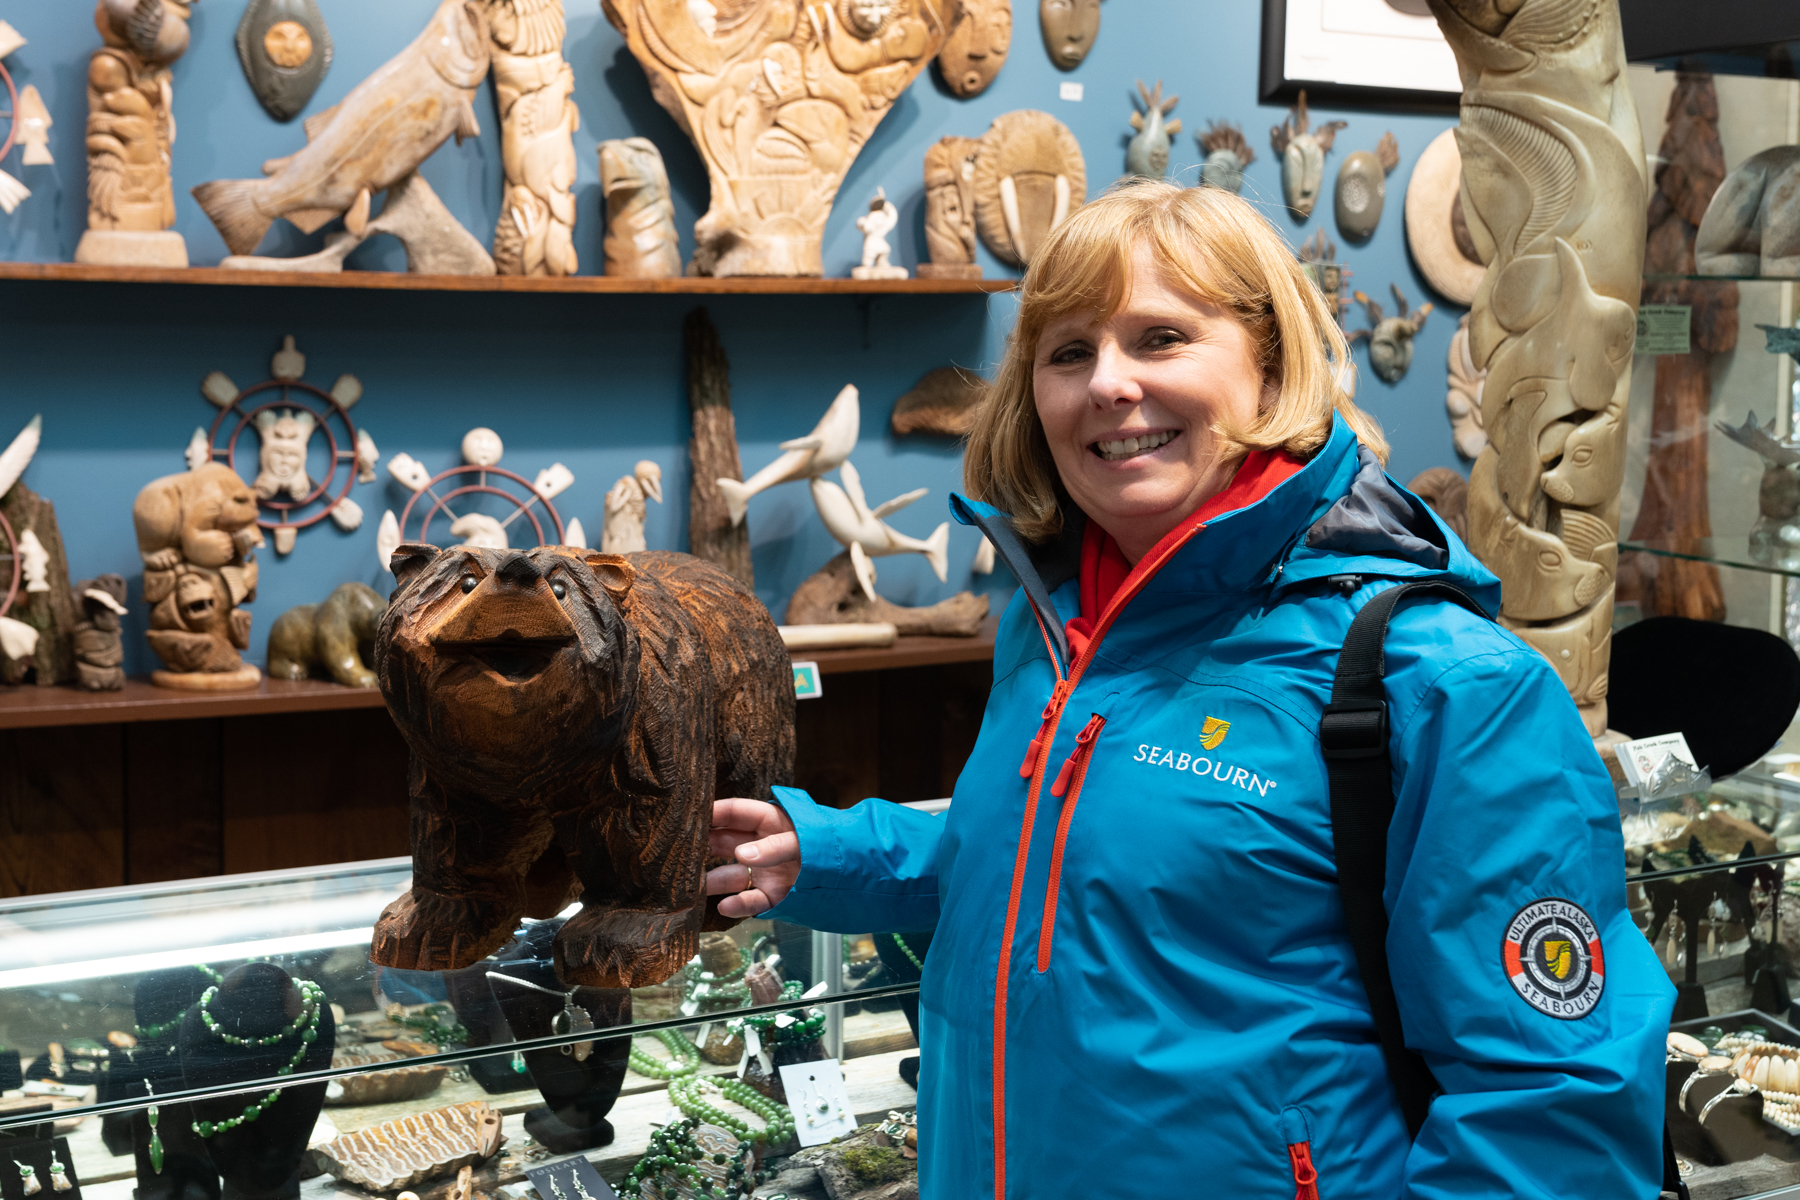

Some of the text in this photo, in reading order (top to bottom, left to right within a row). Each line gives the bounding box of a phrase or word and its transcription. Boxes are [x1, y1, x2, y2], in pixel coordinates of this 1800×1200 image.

[1510, 903, 1595, 941] ULTIMATE ALASKA
[1521, 981, 1600, 1014] SEABOURN
